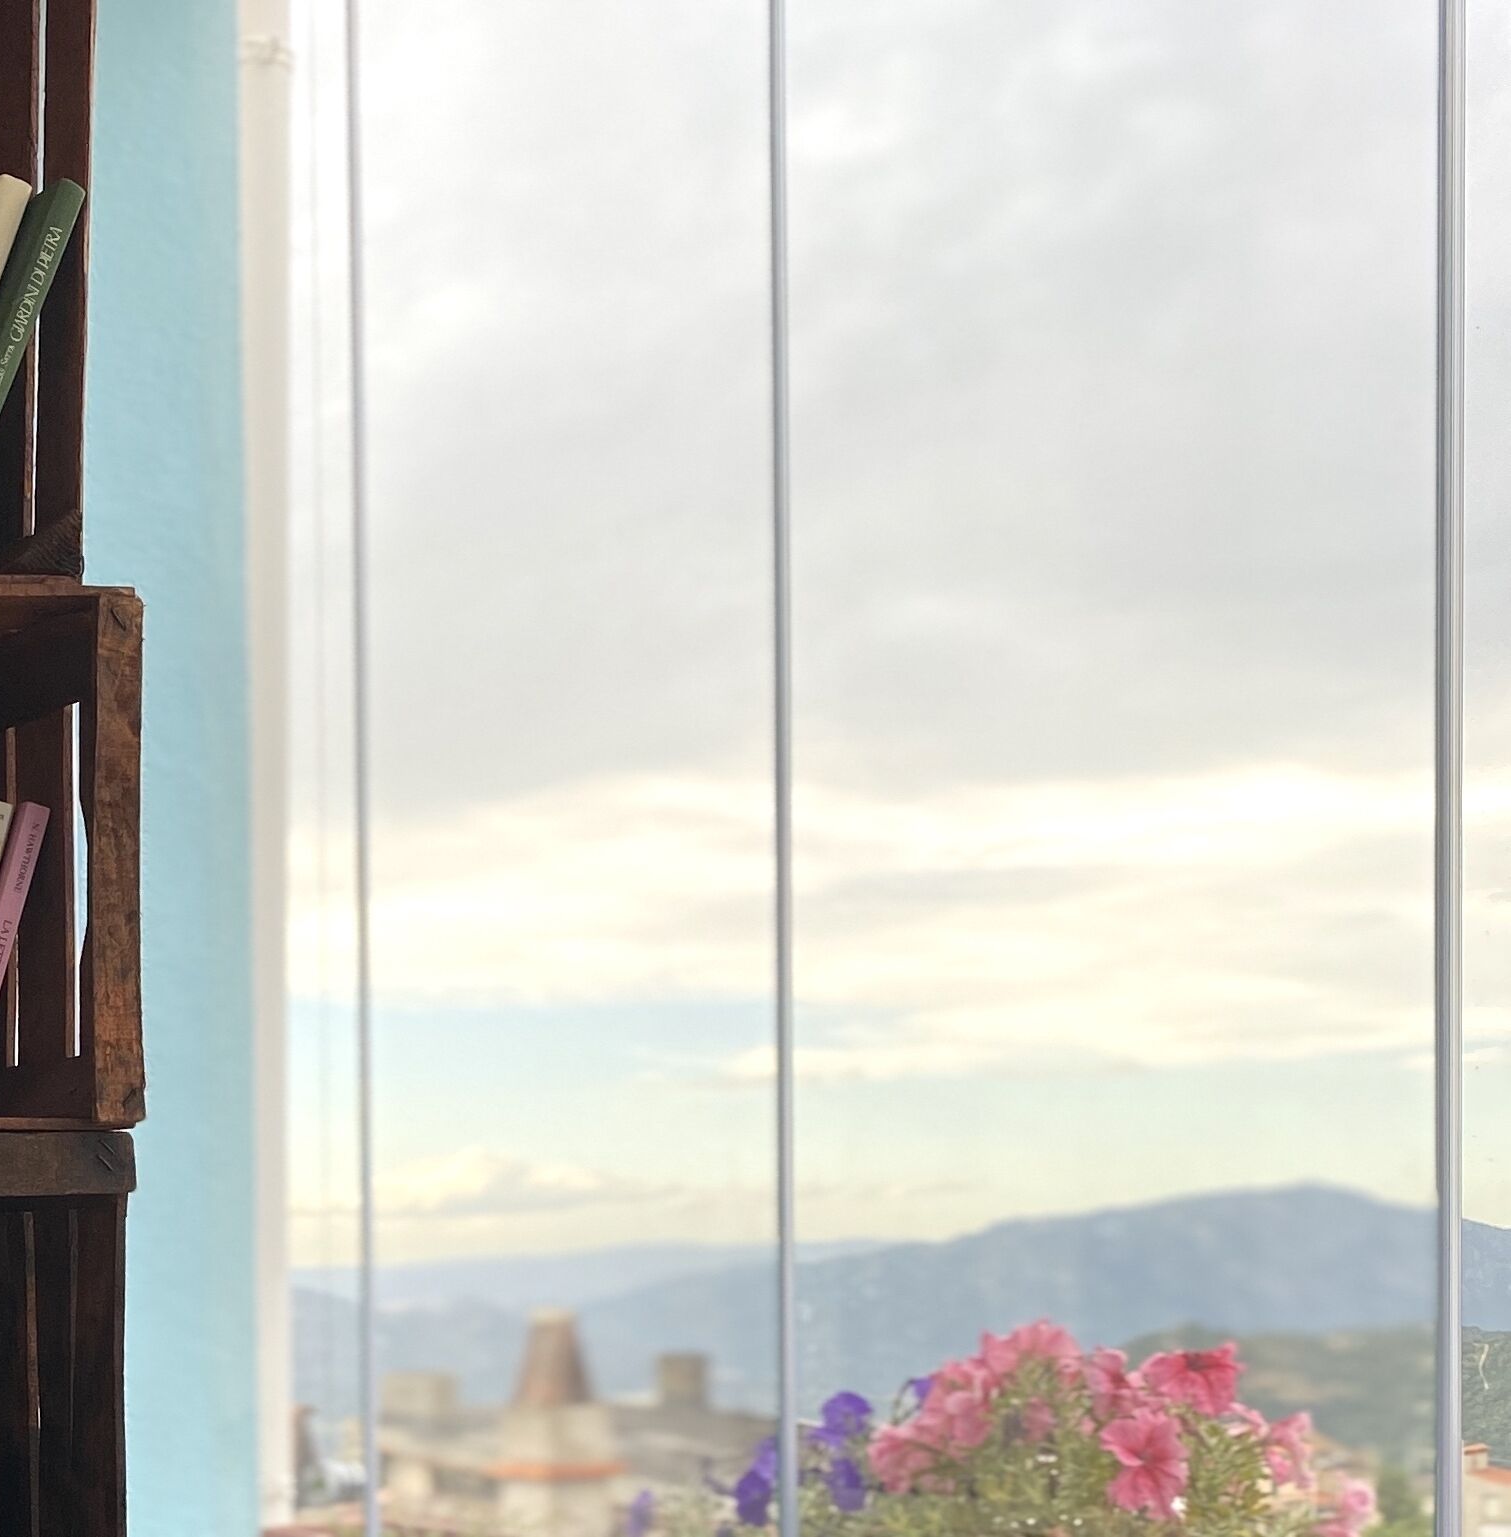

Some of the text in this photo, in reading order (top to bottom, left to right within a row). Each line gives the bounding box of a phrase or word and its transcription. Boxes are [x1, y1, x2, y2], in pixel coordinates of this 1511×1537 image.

[10, 226, 63, 342] GIARDINI DI PIETRA
[14, 832, 37, 893] HAWTHORNE
[0, 919, 13, 936] LA
